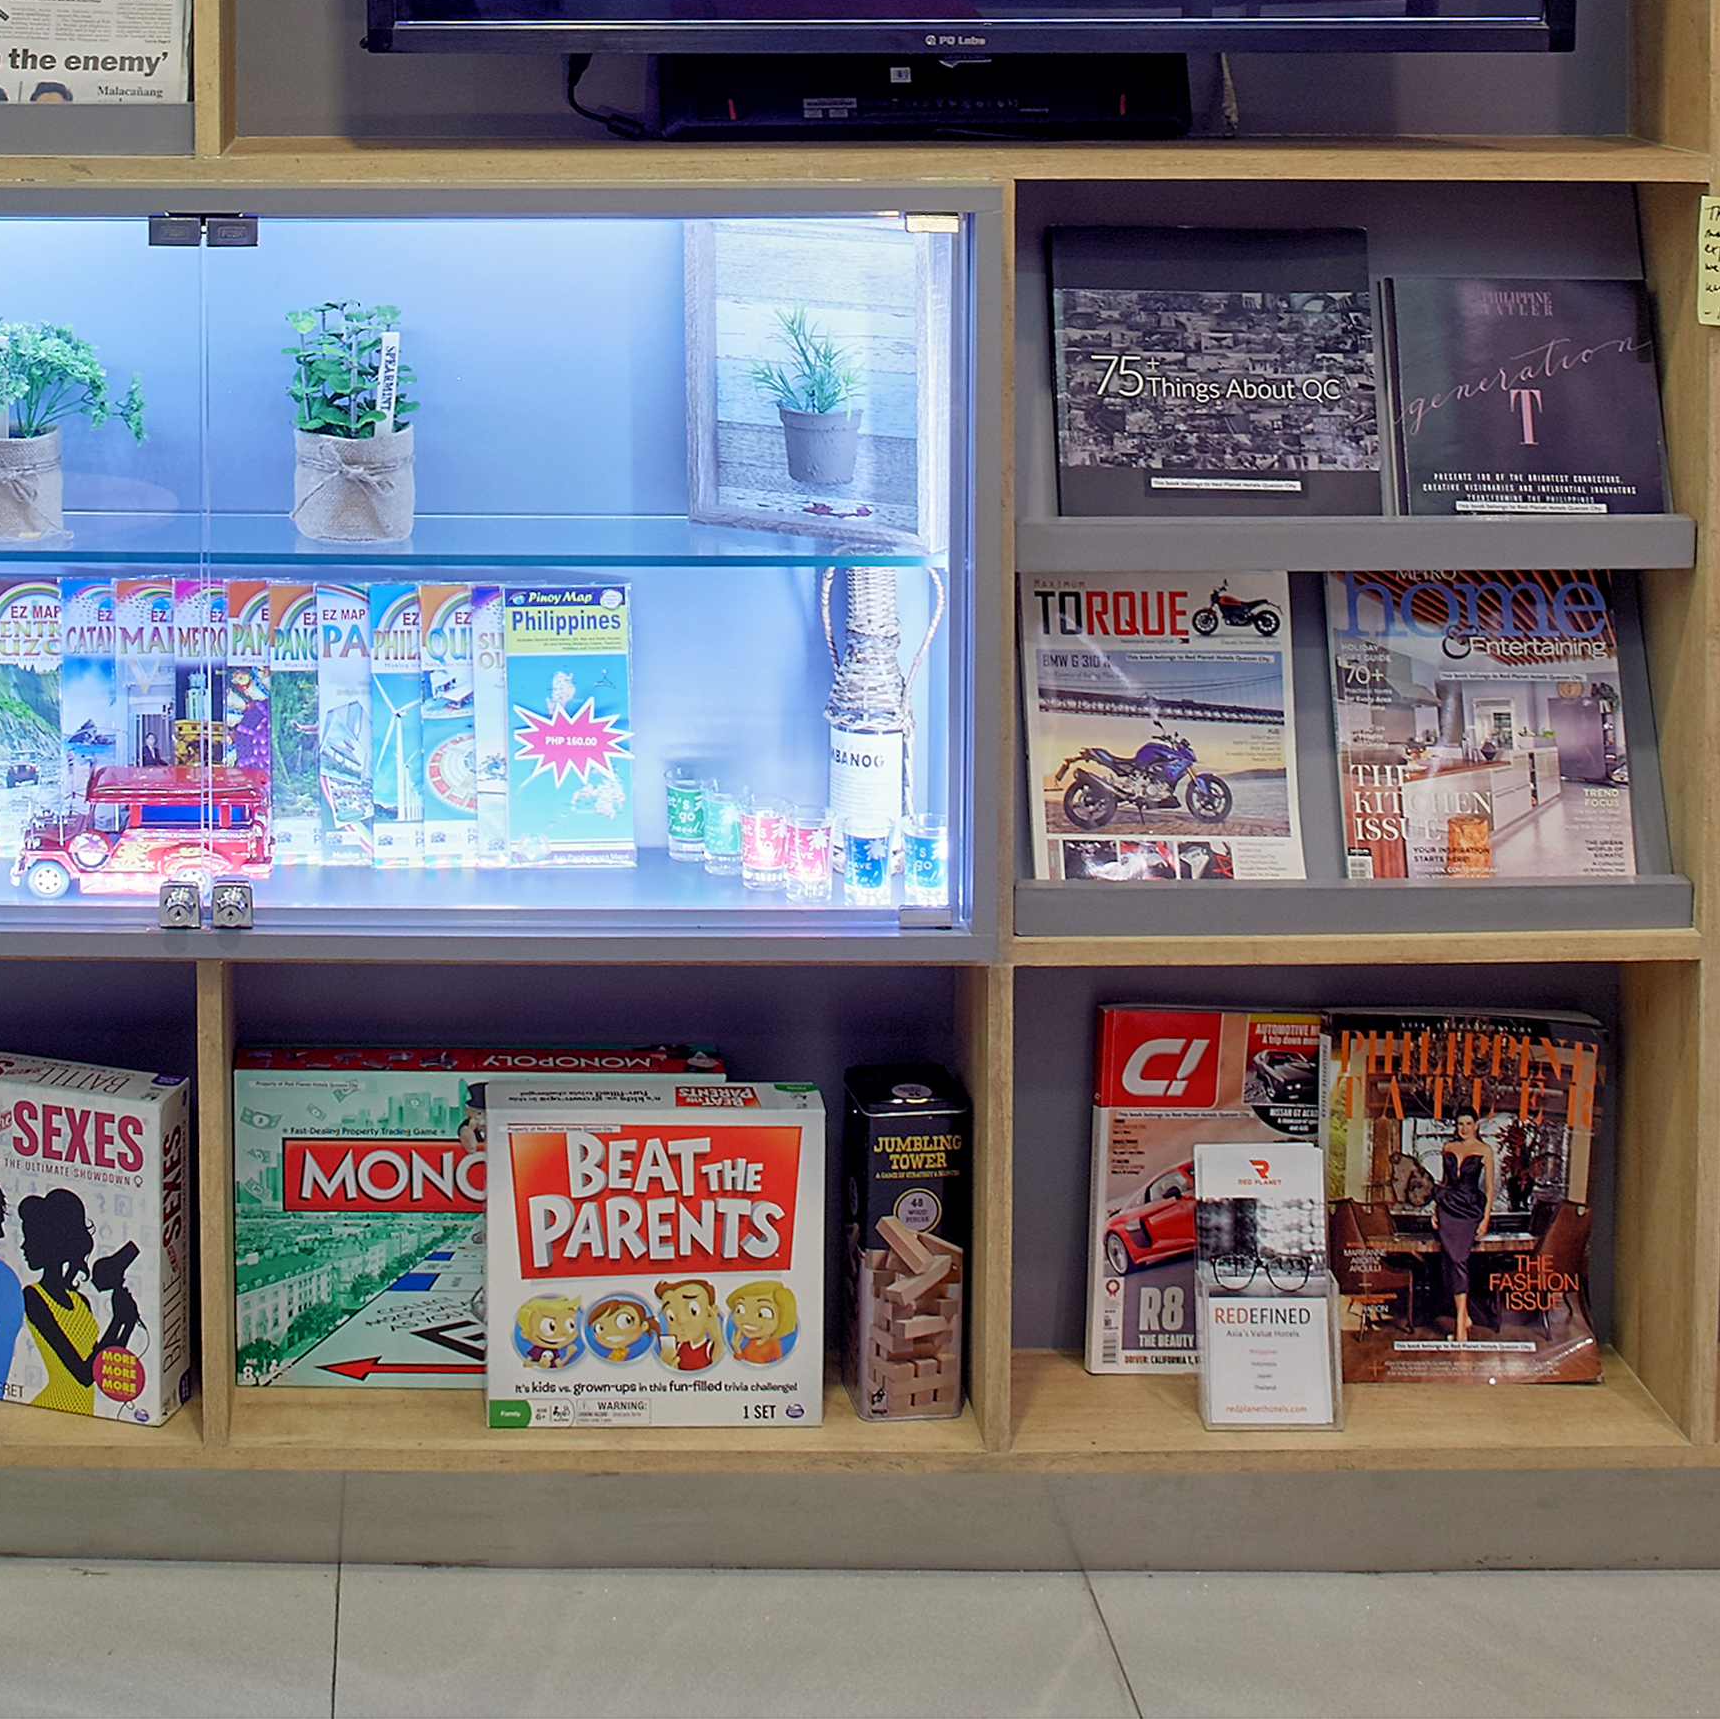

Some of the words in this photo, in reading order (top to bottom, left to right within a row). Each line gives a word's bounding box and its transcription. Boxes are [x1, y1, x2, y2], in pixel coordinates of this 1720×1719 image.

[7, 47, 57, 70] the
[1145, 375, 1221, 402] Things
[1226, 377, 1296, 401] About
[1302, 378, 1341, 401] QC
[1394, 337, 1652, 435] generation
[1510, 389, 1543, 445] T
[528, 592, 561, 605] Pinoy
[563, 592, 592, 605] Map
[1340, 571, 1606, 637] home
[512, 612, 622, 634] Philippines
[1034, 591, 1190, 636] TORQUE
[1469, 637, 1607, 658] Entertaining
[545, 735, 562, 747] PHP
[563, 735, 597, 747] 160.00
[13, 1100, 144, 1172] SEXES
[874, 1135, 961, 1153] JUMBLING
[566, 1131, 711, 1198] BEAT
[701, 1158, 764, 1192] THE
[889, 1152, 947, 1169] TOWER
[529, 1194, 785, 1268] PARENTS
[1514, 1255, 1554, 1272] THE
[1489, 1274, 1580, 1291] FASHION
[1505, 1292, 1564, 1311] ISSUE
[1215, 1308, 1311, 1324] REDEFINED
[1226, 1404, 1307, 1414] redplanethotels.com
